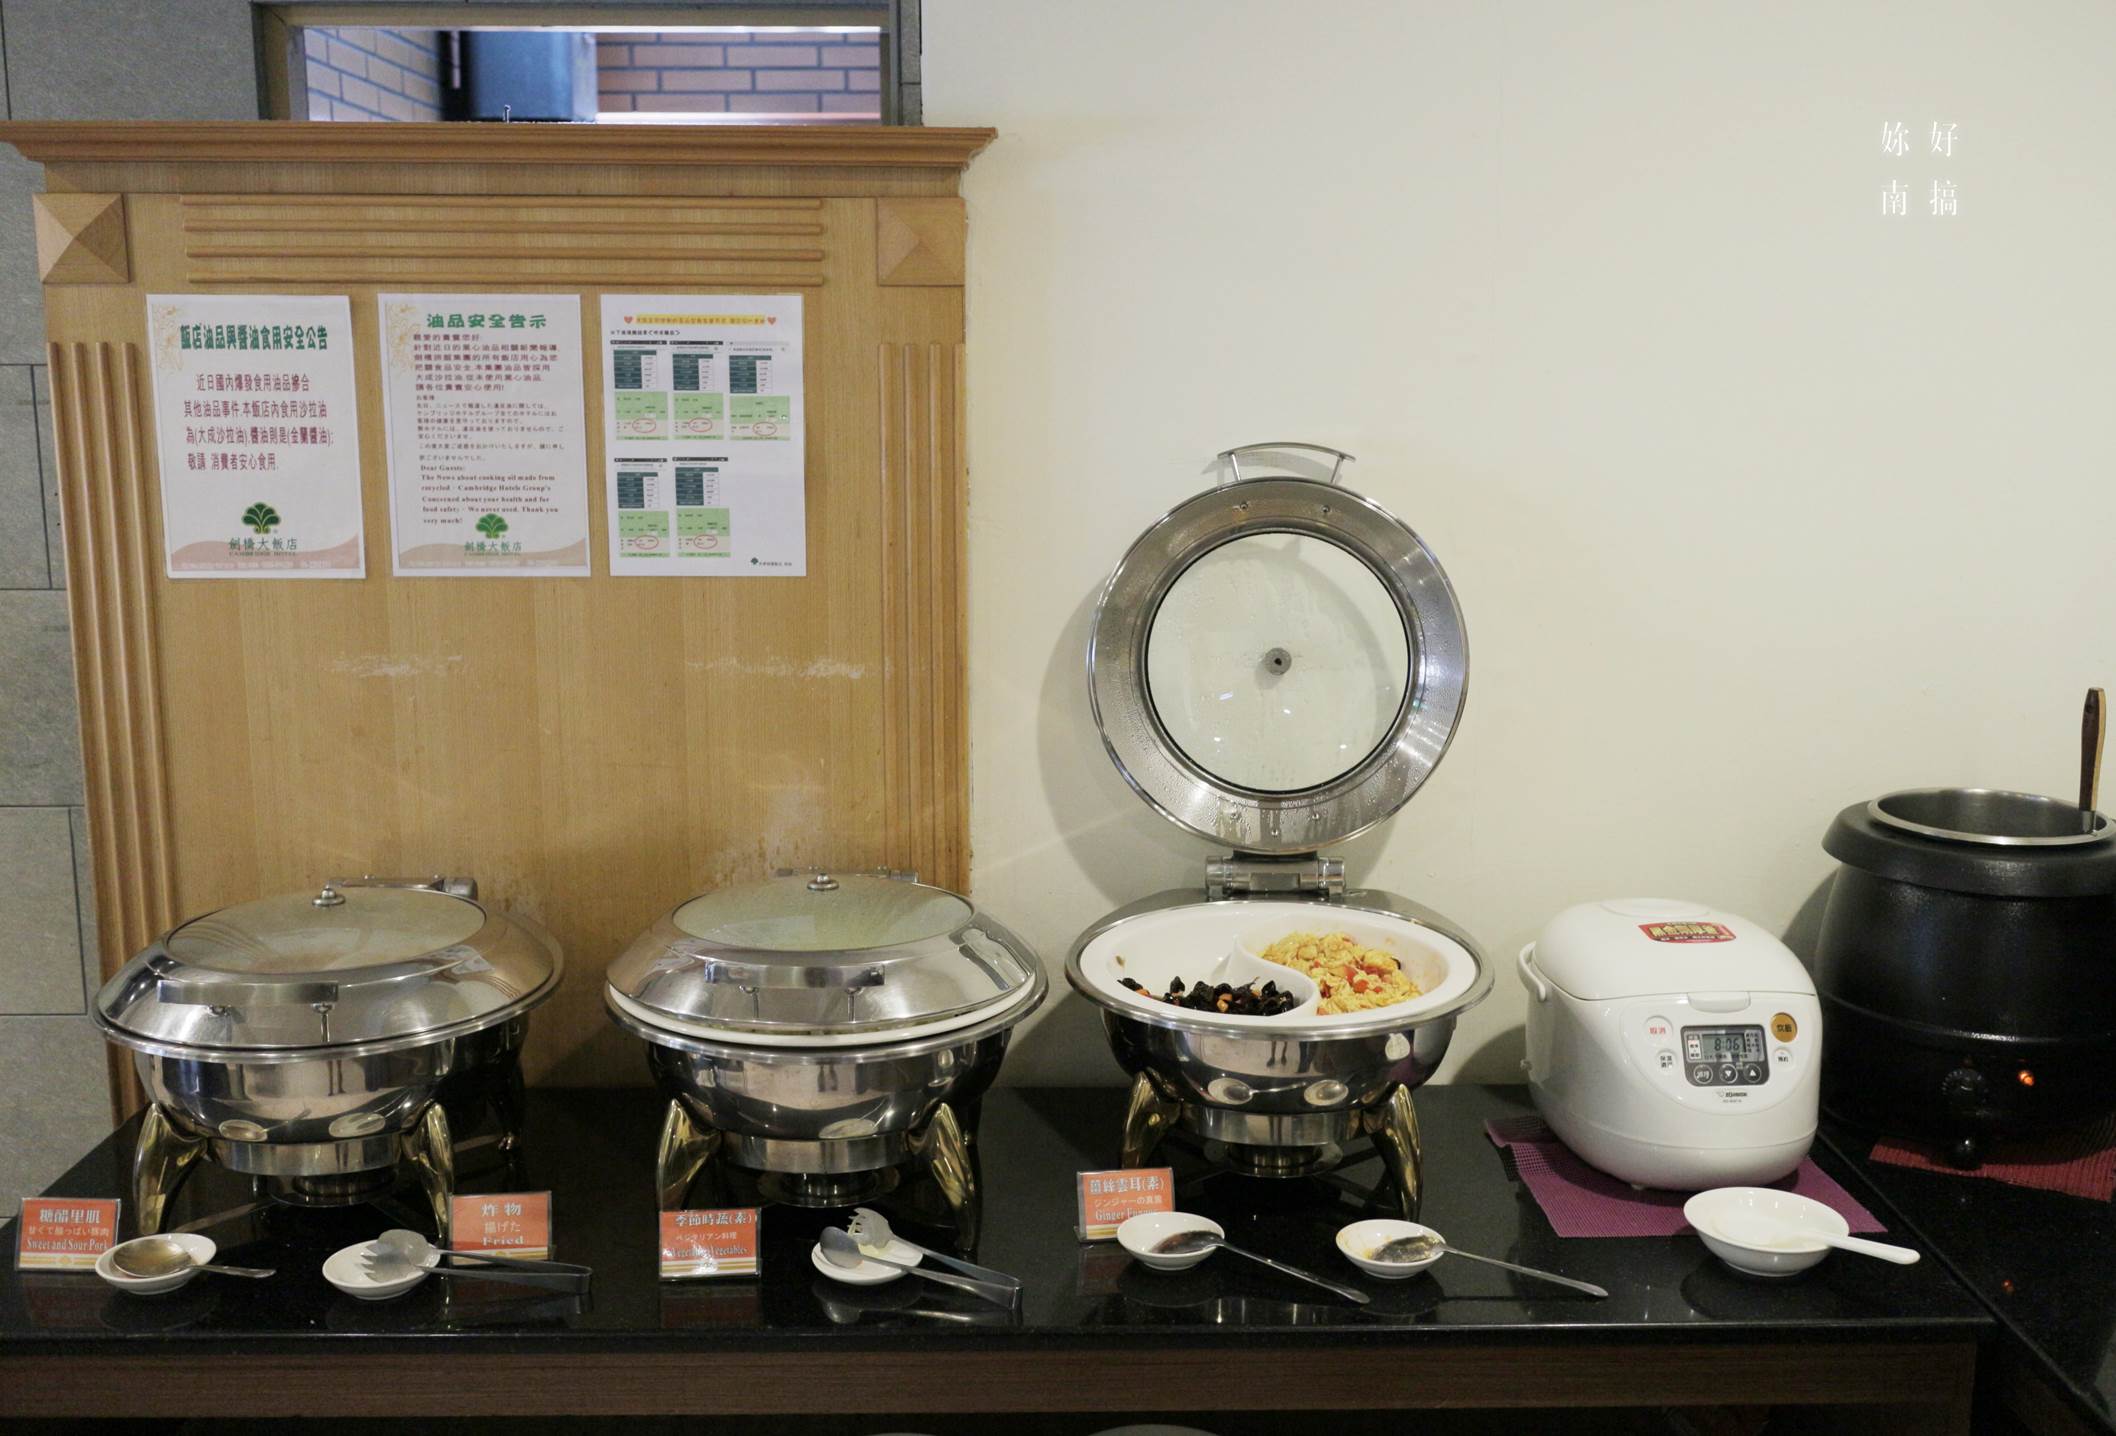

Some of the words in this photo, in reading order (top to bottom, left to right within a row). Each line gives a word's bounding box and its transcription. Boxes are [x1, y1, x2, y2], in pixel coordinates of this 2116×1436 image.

[427, 313, 547, 329] 油品安全告示
[180, 323, 328, 350] 飯店油品與醬油食用安全公告
[479, 474, 506, 482] cooking
[1713, 1037, 1741, 1051] 8:06
[481, 1202, 523, 1217] 炸物
[1095, 1209, 1125, 1222] Ginger
[26, 1237, 50, 1251] Sweet
[51, 1238, 67, 1250] and
[67, 1239, 88, 1251] Sour
[481, 1235, 525, 1246] Fried
